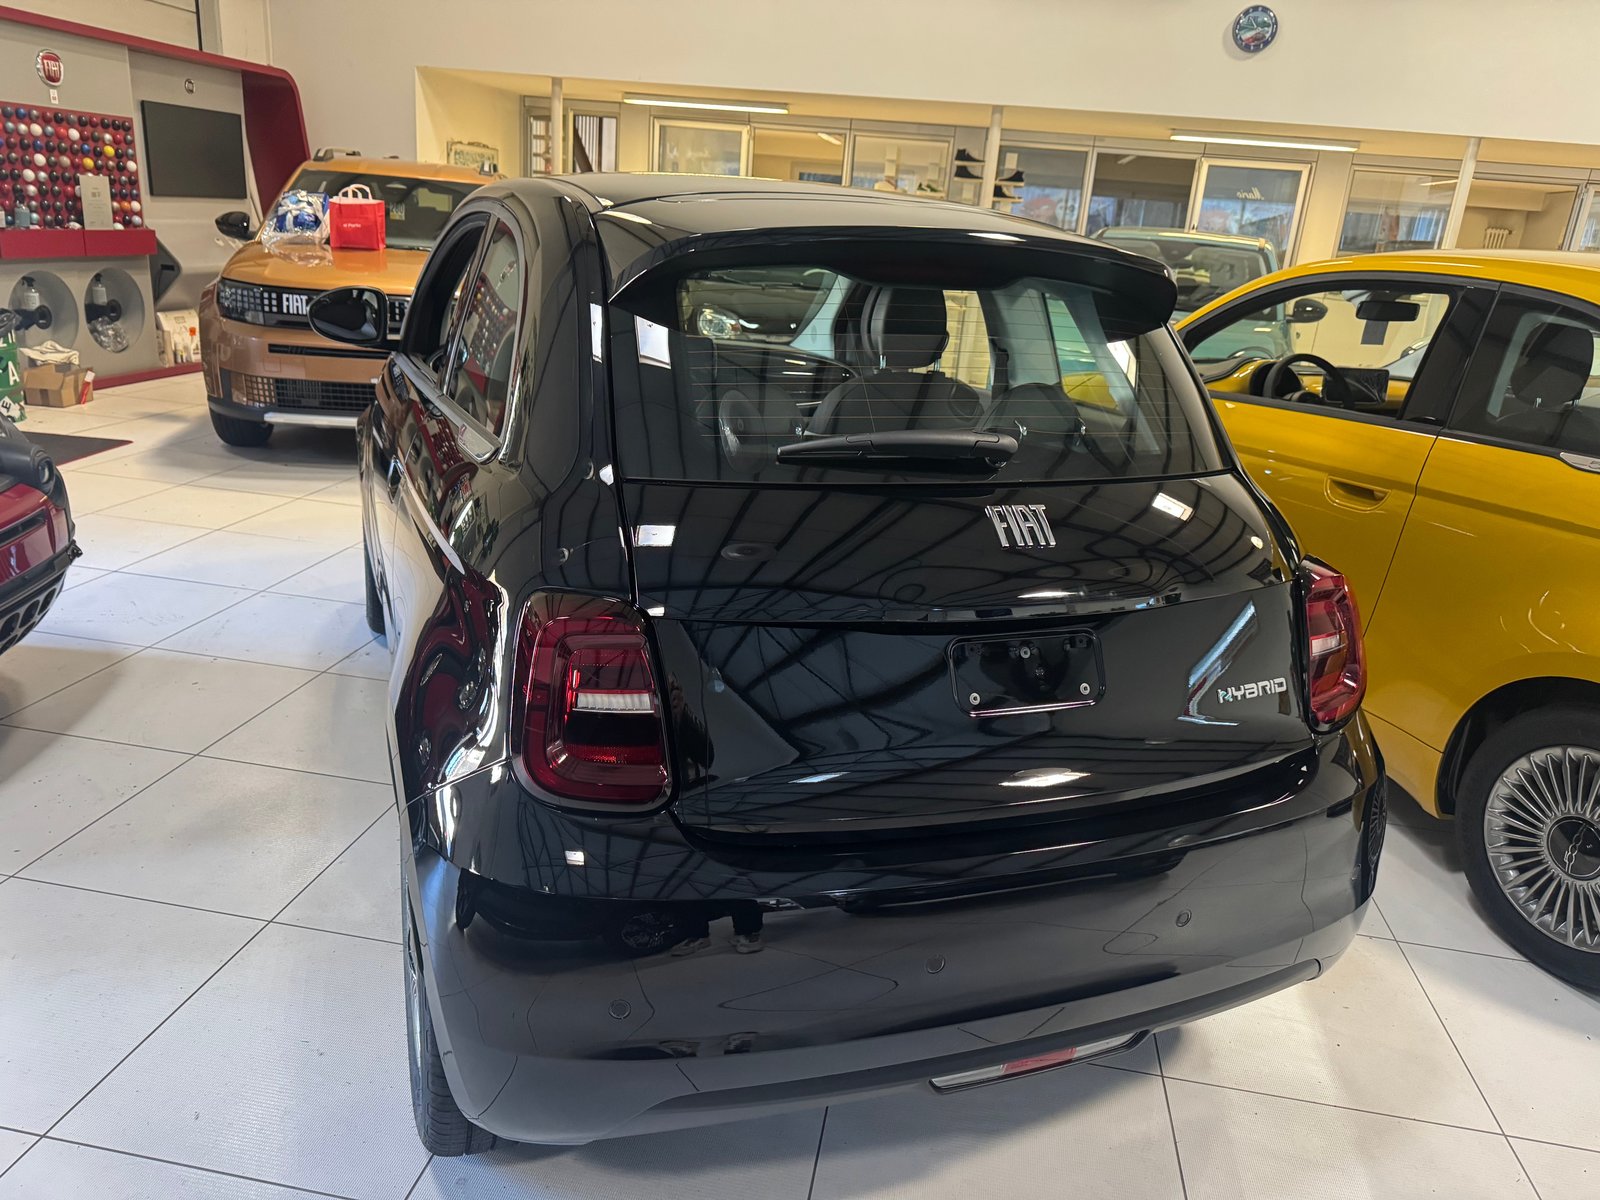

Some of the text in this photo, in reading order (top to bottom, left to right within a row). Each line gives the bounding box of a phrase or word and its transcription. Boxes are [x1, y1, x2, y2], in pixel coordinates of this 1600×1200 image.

[282, 293, 308, 315] FIAT
[984, 504, 1056, 547] FIAT
[1217, 677, 1287, 704] HYBRID
